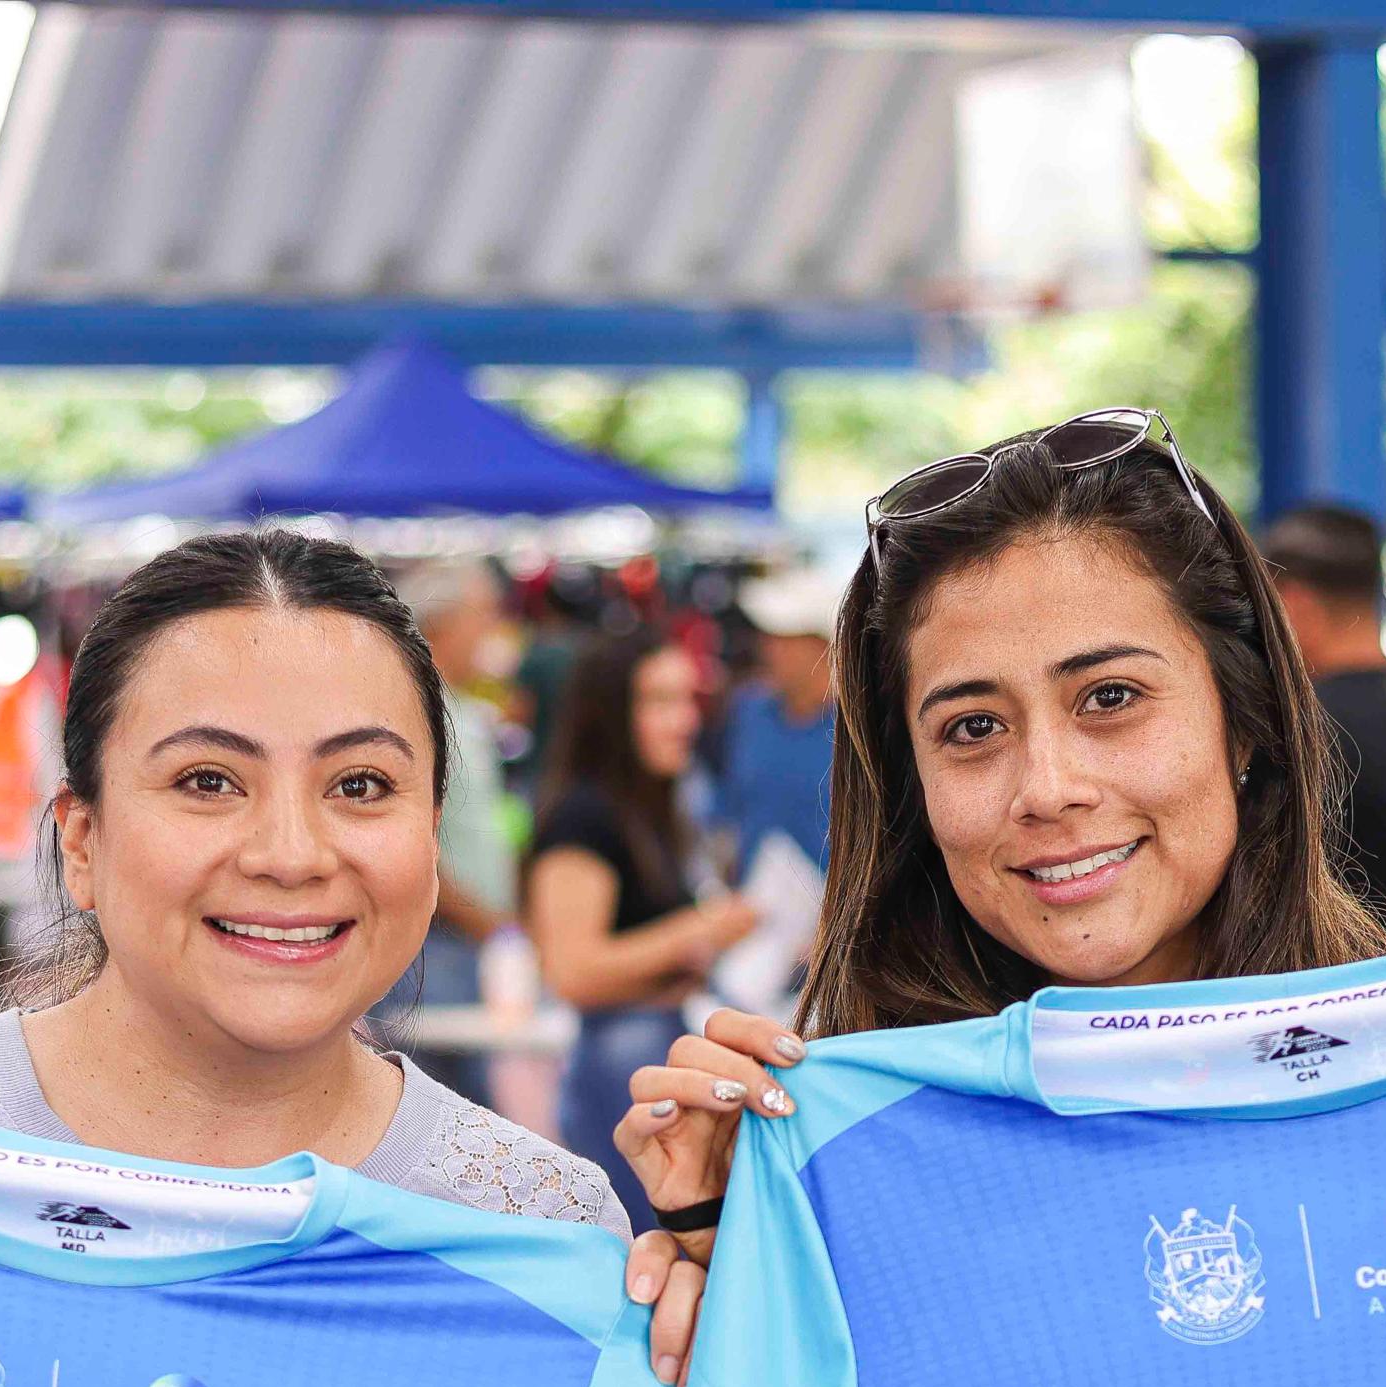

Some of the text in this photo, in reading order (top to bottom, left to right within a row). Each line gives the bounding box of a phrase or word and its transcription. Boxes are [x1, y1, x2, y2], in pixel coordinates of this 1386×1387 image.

[1090, 1015, 1150, 1029] CADA
[1280, 1054, 1332, 1071] TALLA
[1296, 1070, 1321, 1082] CH
[17, 1155, 46, 1167] ES
[55, 1161, 110, 1175] POR
[56, 1226, 106, 1241] TALLA
[1369, 1296, 1385, 1315] A
